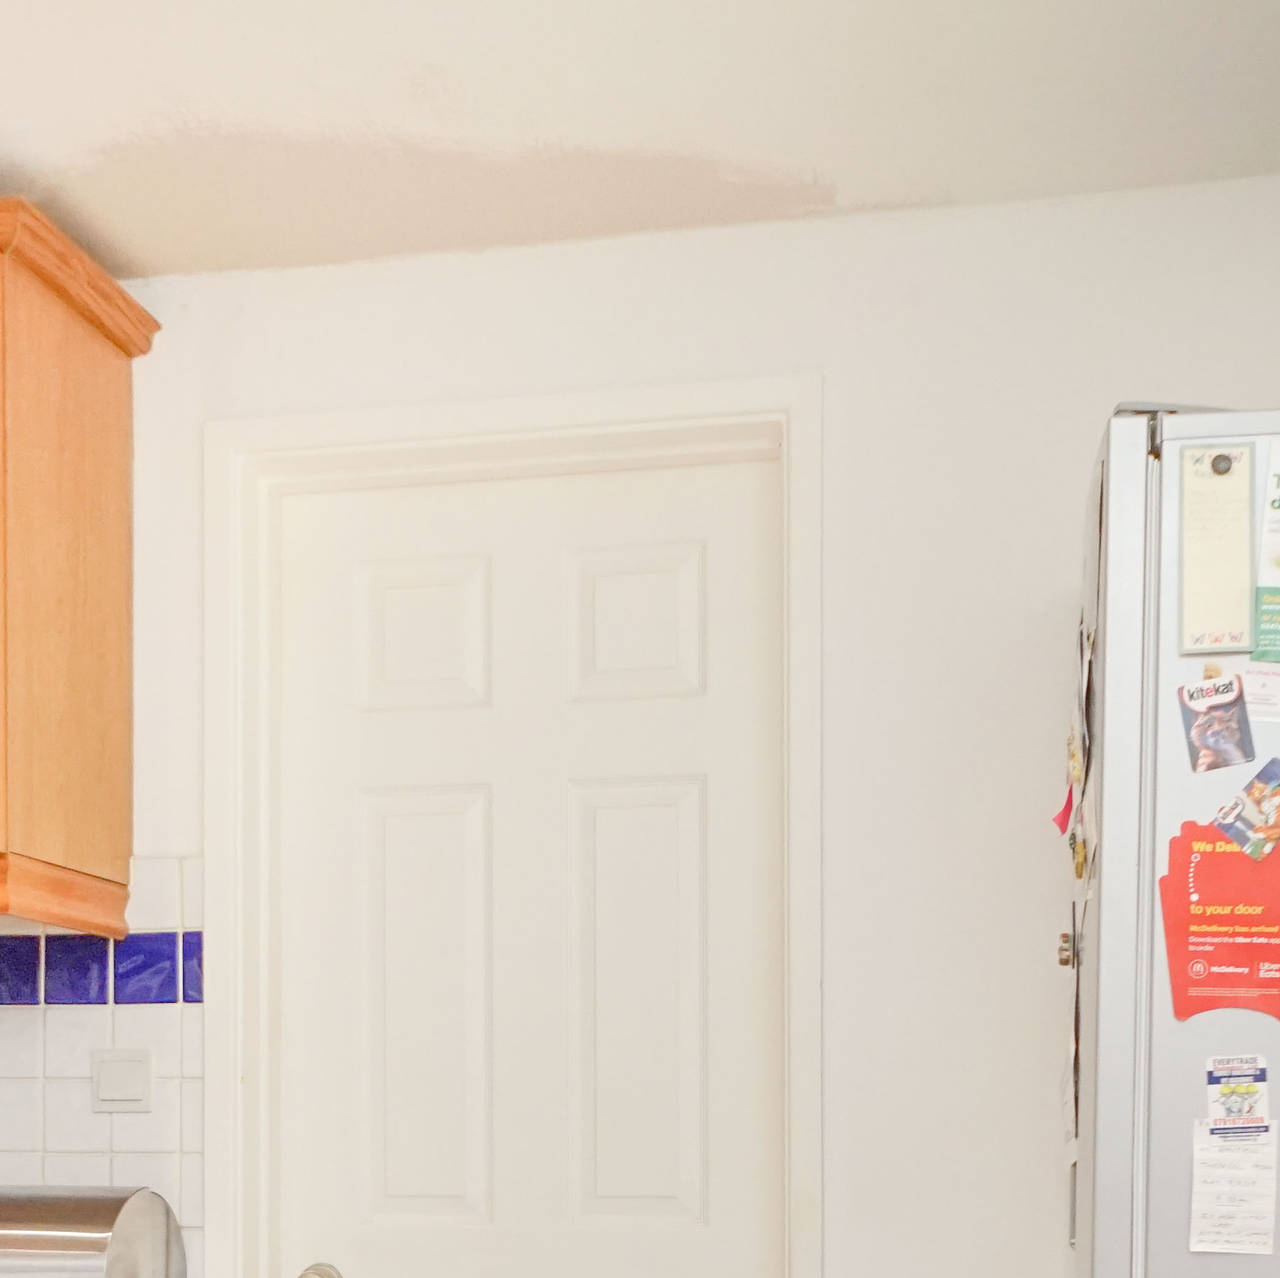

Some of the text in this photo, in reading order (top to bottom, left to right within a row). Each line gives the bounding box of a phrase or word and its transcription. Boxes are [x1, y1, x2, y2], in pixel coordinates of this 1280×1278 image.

[1187, 680, 1235, 701] kitekat
[1191, 840, 1214, 852] We
[1190, 903, 1264, 917] to your door
[1259, 961, 1280, 970] Uber
[1259, 969, 1280, 978] Eats
